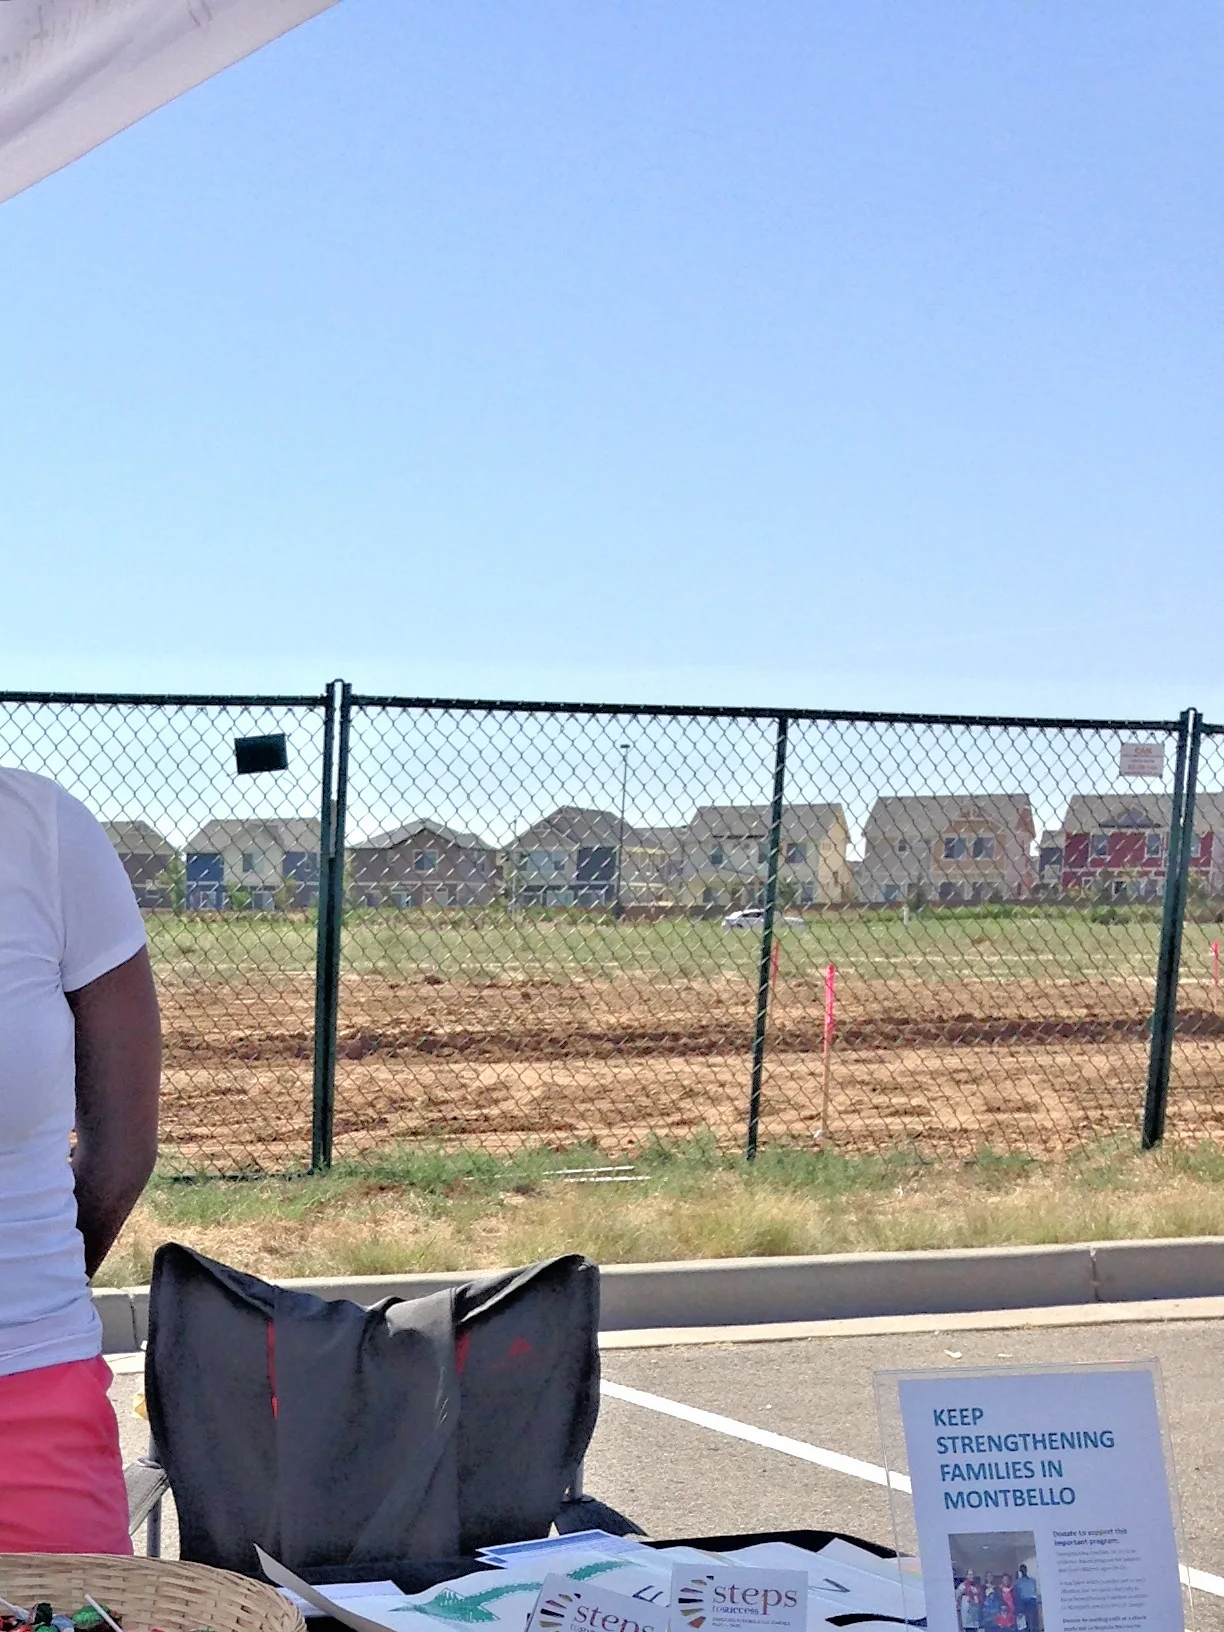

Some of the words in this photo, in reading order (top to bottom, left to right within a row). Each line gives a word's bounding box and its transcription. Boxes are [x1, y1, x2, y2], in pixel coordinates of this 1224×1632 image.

[934, 1407, 984, 1427] KEEP
[936, 1430, 1115, 1455] STRENGTHENING
[940, 1461, 1035, 1482] FAMILIES
[1041, 1459, 1064, 1479] IN
[944, 1486, 1076, 1510] MONTBELLO
[713, 1584, 798, 1616] steps
